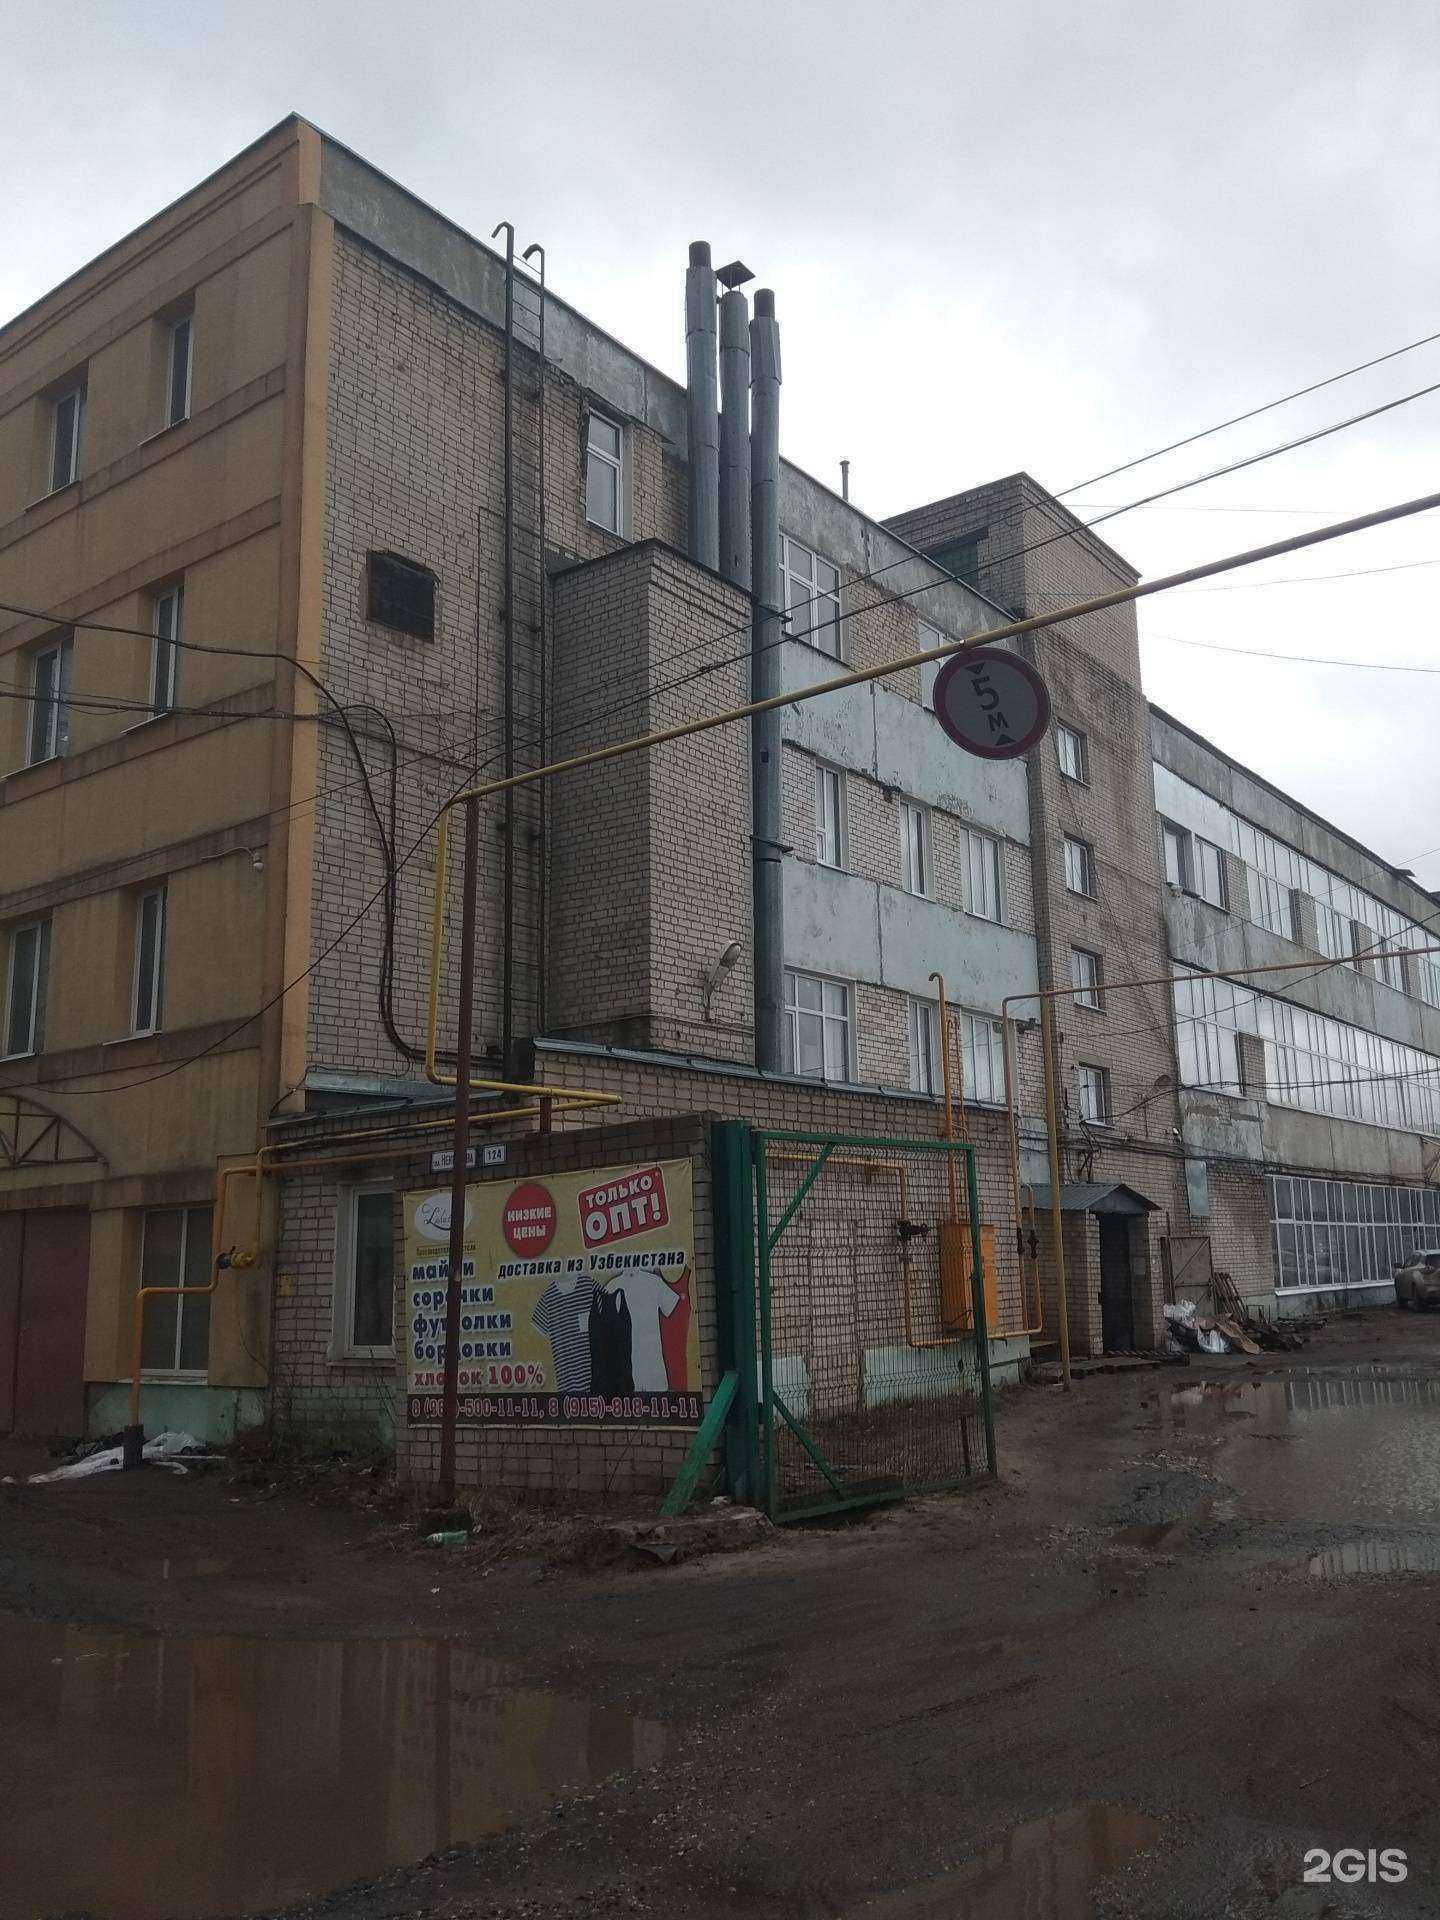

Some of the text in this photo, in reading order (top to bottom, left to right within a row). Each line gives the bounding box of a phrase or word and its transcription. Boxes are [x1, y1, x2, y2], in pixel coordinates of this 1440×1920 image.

[971, 676, 999, 710] 5
[586, 1192, 661, 1240] ОПТ!
[412, 1259, 474, 1279] майи
[498, 1251, 685, 1279] доставка из Узбекистана
[413, 1313, 512, 1339] футолки
[414, 1339, 511, 1365] боровки
[414, 1362, 543, 1386] хлоок 100%
[411, 1398, 421, 1418] 8
[548, 1397, 559, 1417] 8
